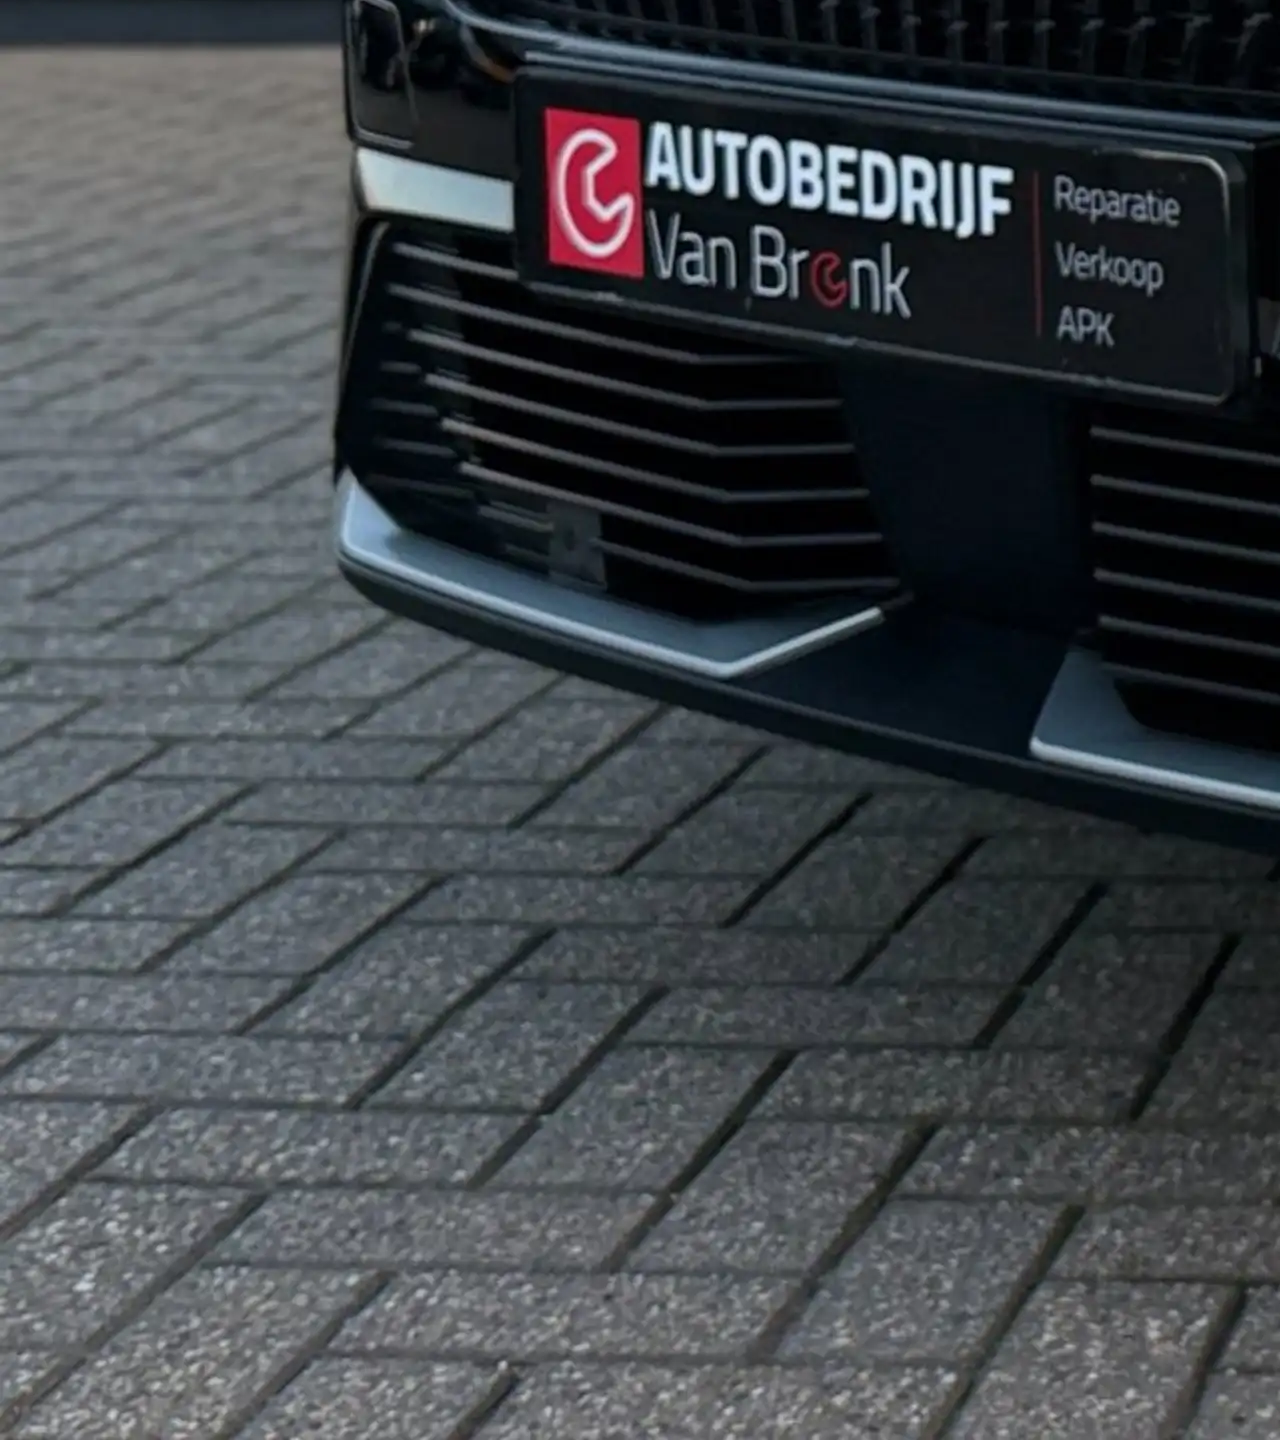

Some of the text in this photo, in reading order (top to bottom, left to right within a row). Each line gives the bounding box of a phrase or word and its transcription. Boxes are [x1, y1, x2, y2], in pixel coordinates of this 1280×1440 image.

[645, 120, 1016, 240] AUTOBEDRIJF
[1053, 173, 1182, 229] Reparatie
[645, 209, 738, 290] Van
[1055, 240, 1166, 295] Verkoop
[1056, 305, 1117, 347] APK
